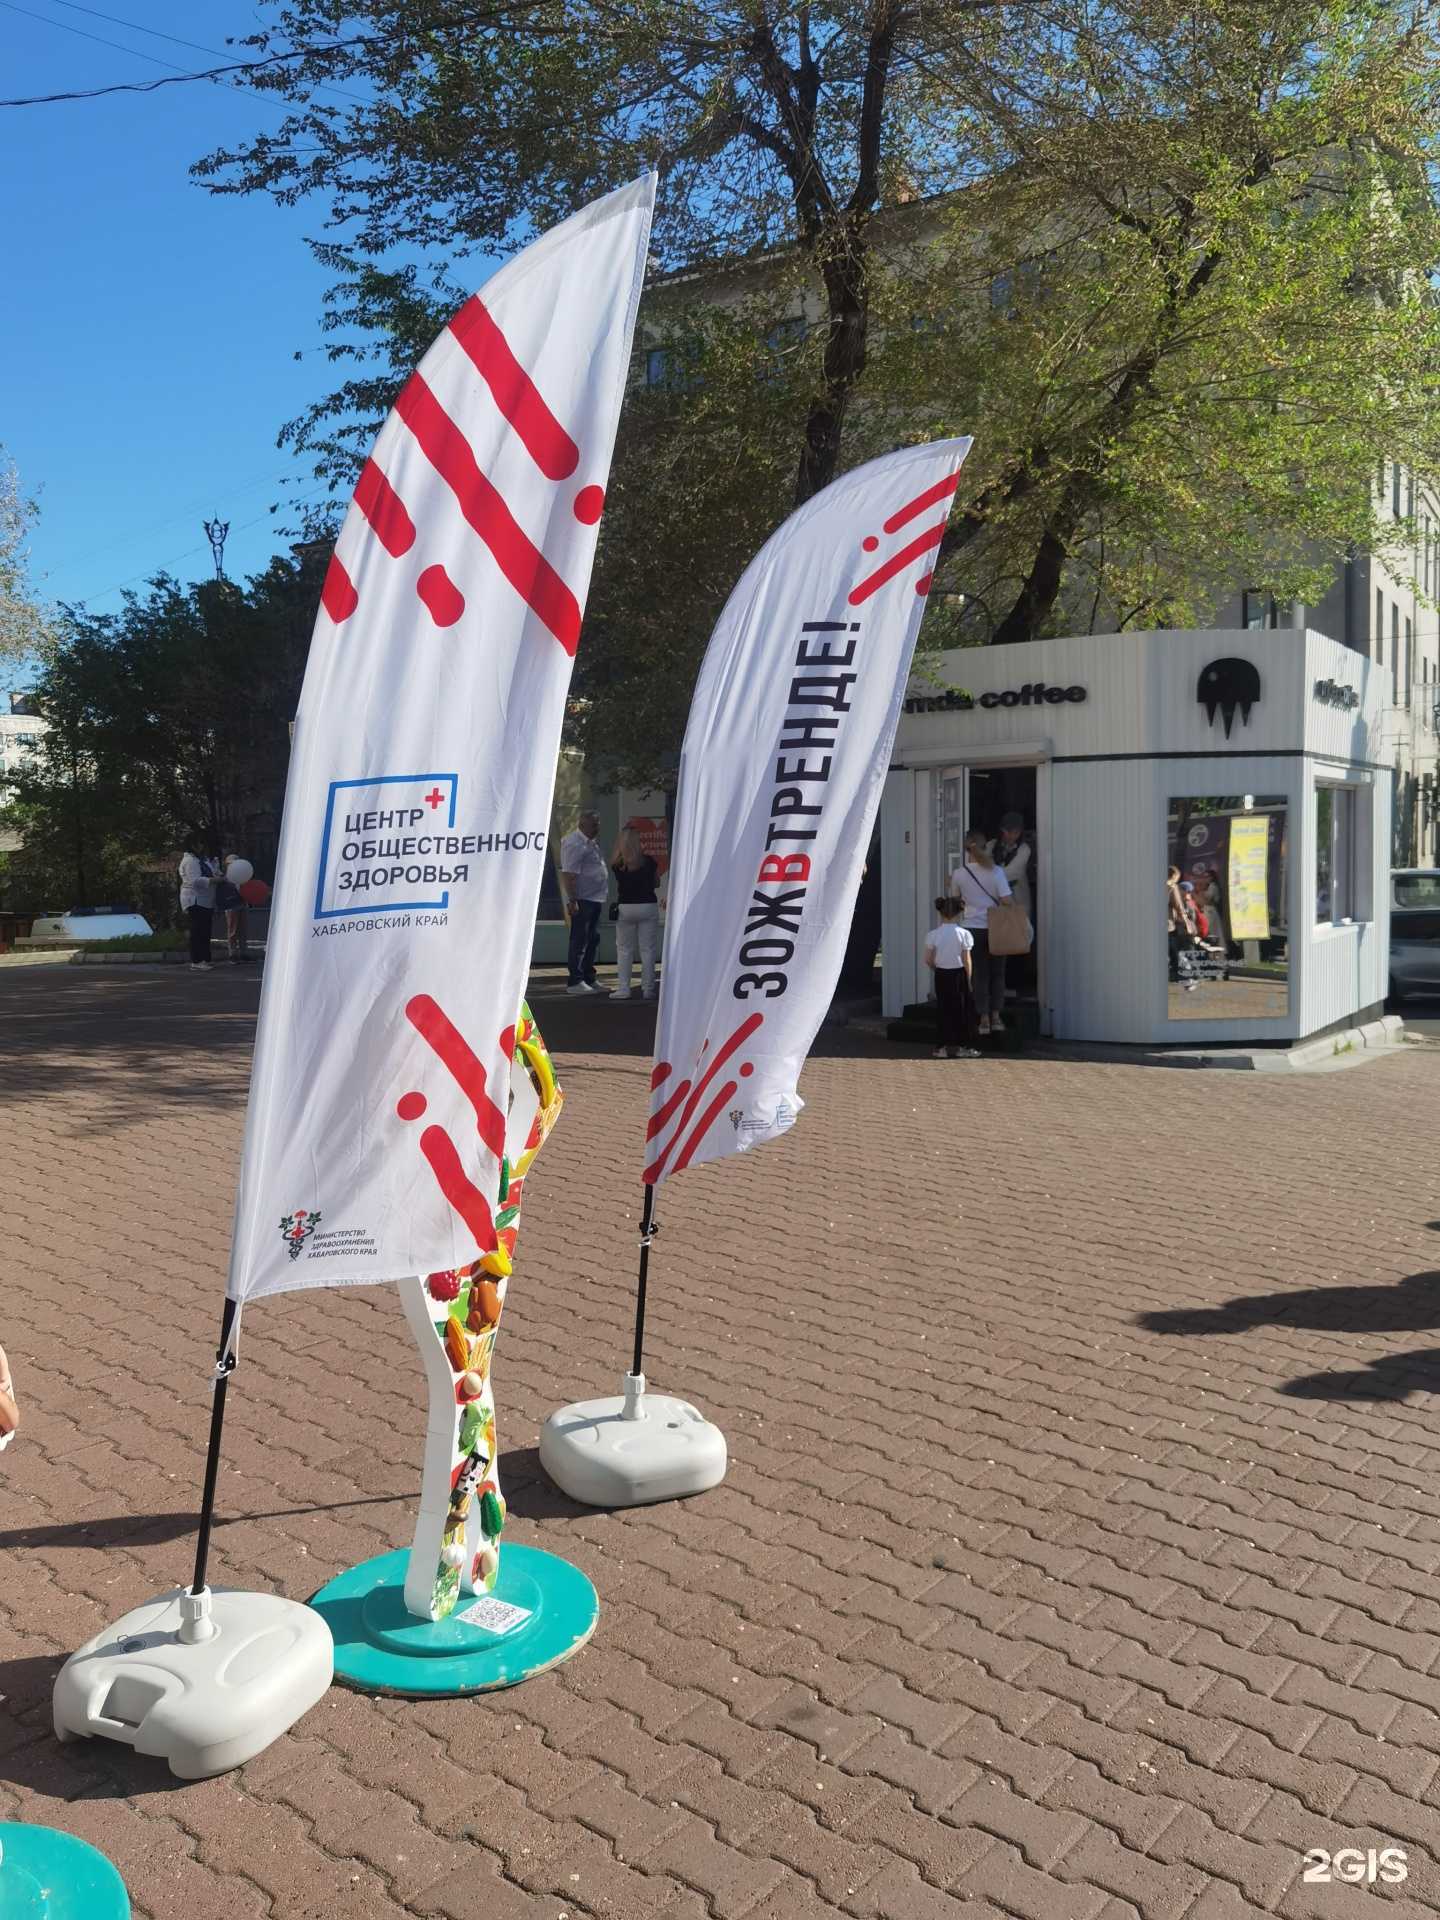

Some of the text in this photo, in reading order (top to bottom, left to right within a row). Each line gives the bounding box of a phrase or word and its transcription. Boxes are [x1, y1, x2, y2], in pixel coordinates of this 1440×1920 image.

[980, 683, 1087, 709] coffee
[344, 808, 424, 834] ЦЕНТР
[338, 864, 469, 892] ЗДОРОВЬЯ
[312, 913, 448, 938] ХАБАРОВСКИЙ КРАЙ
[313, 1229, 367, 1241] МИНИСТЕРСТВО
[359, 1248, 378, 1256] КРАЯ
